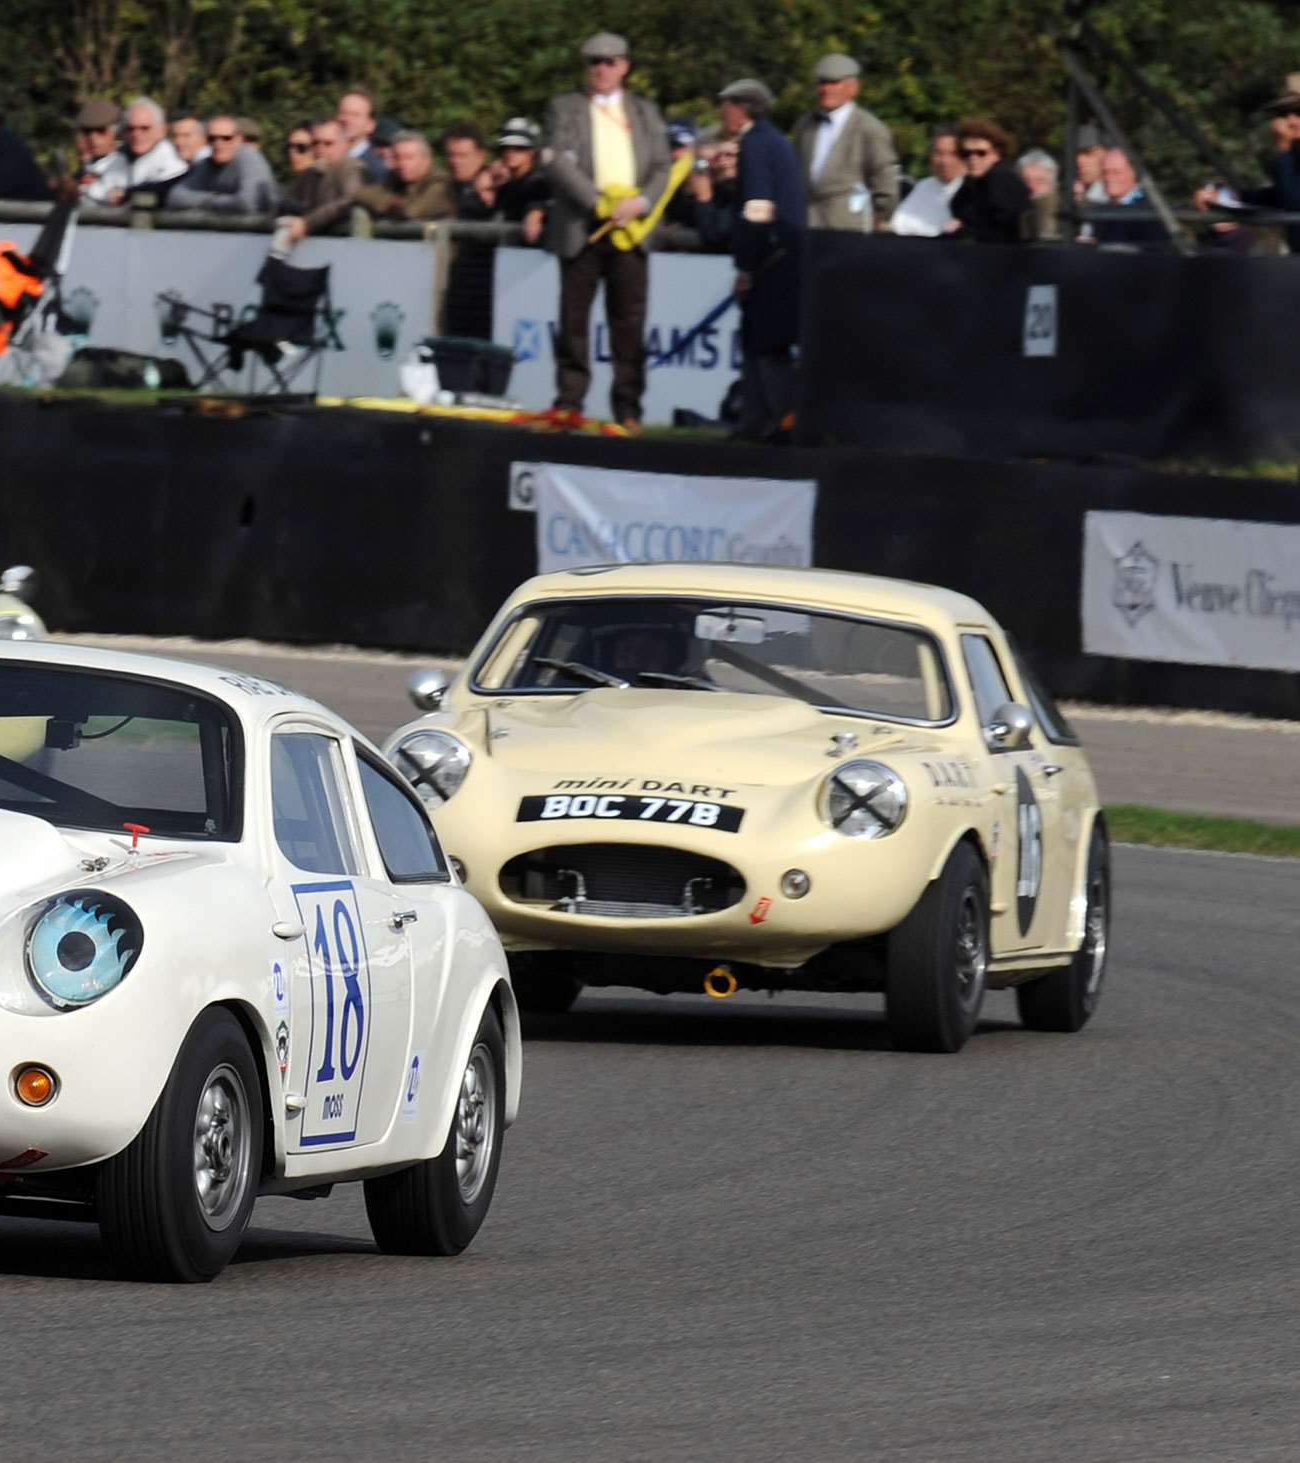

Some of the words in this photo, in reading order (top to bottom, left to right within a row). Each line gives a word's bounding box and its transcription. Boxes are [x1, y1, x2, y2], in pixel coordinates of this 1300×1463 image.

[553, 776, 636, 790] mini
[640, 780, 738, 799] DART
[540, 795, 626, 819] BOC
[639, 797, 722, 826] 77B
[314, 899, 364, 1083] 18
